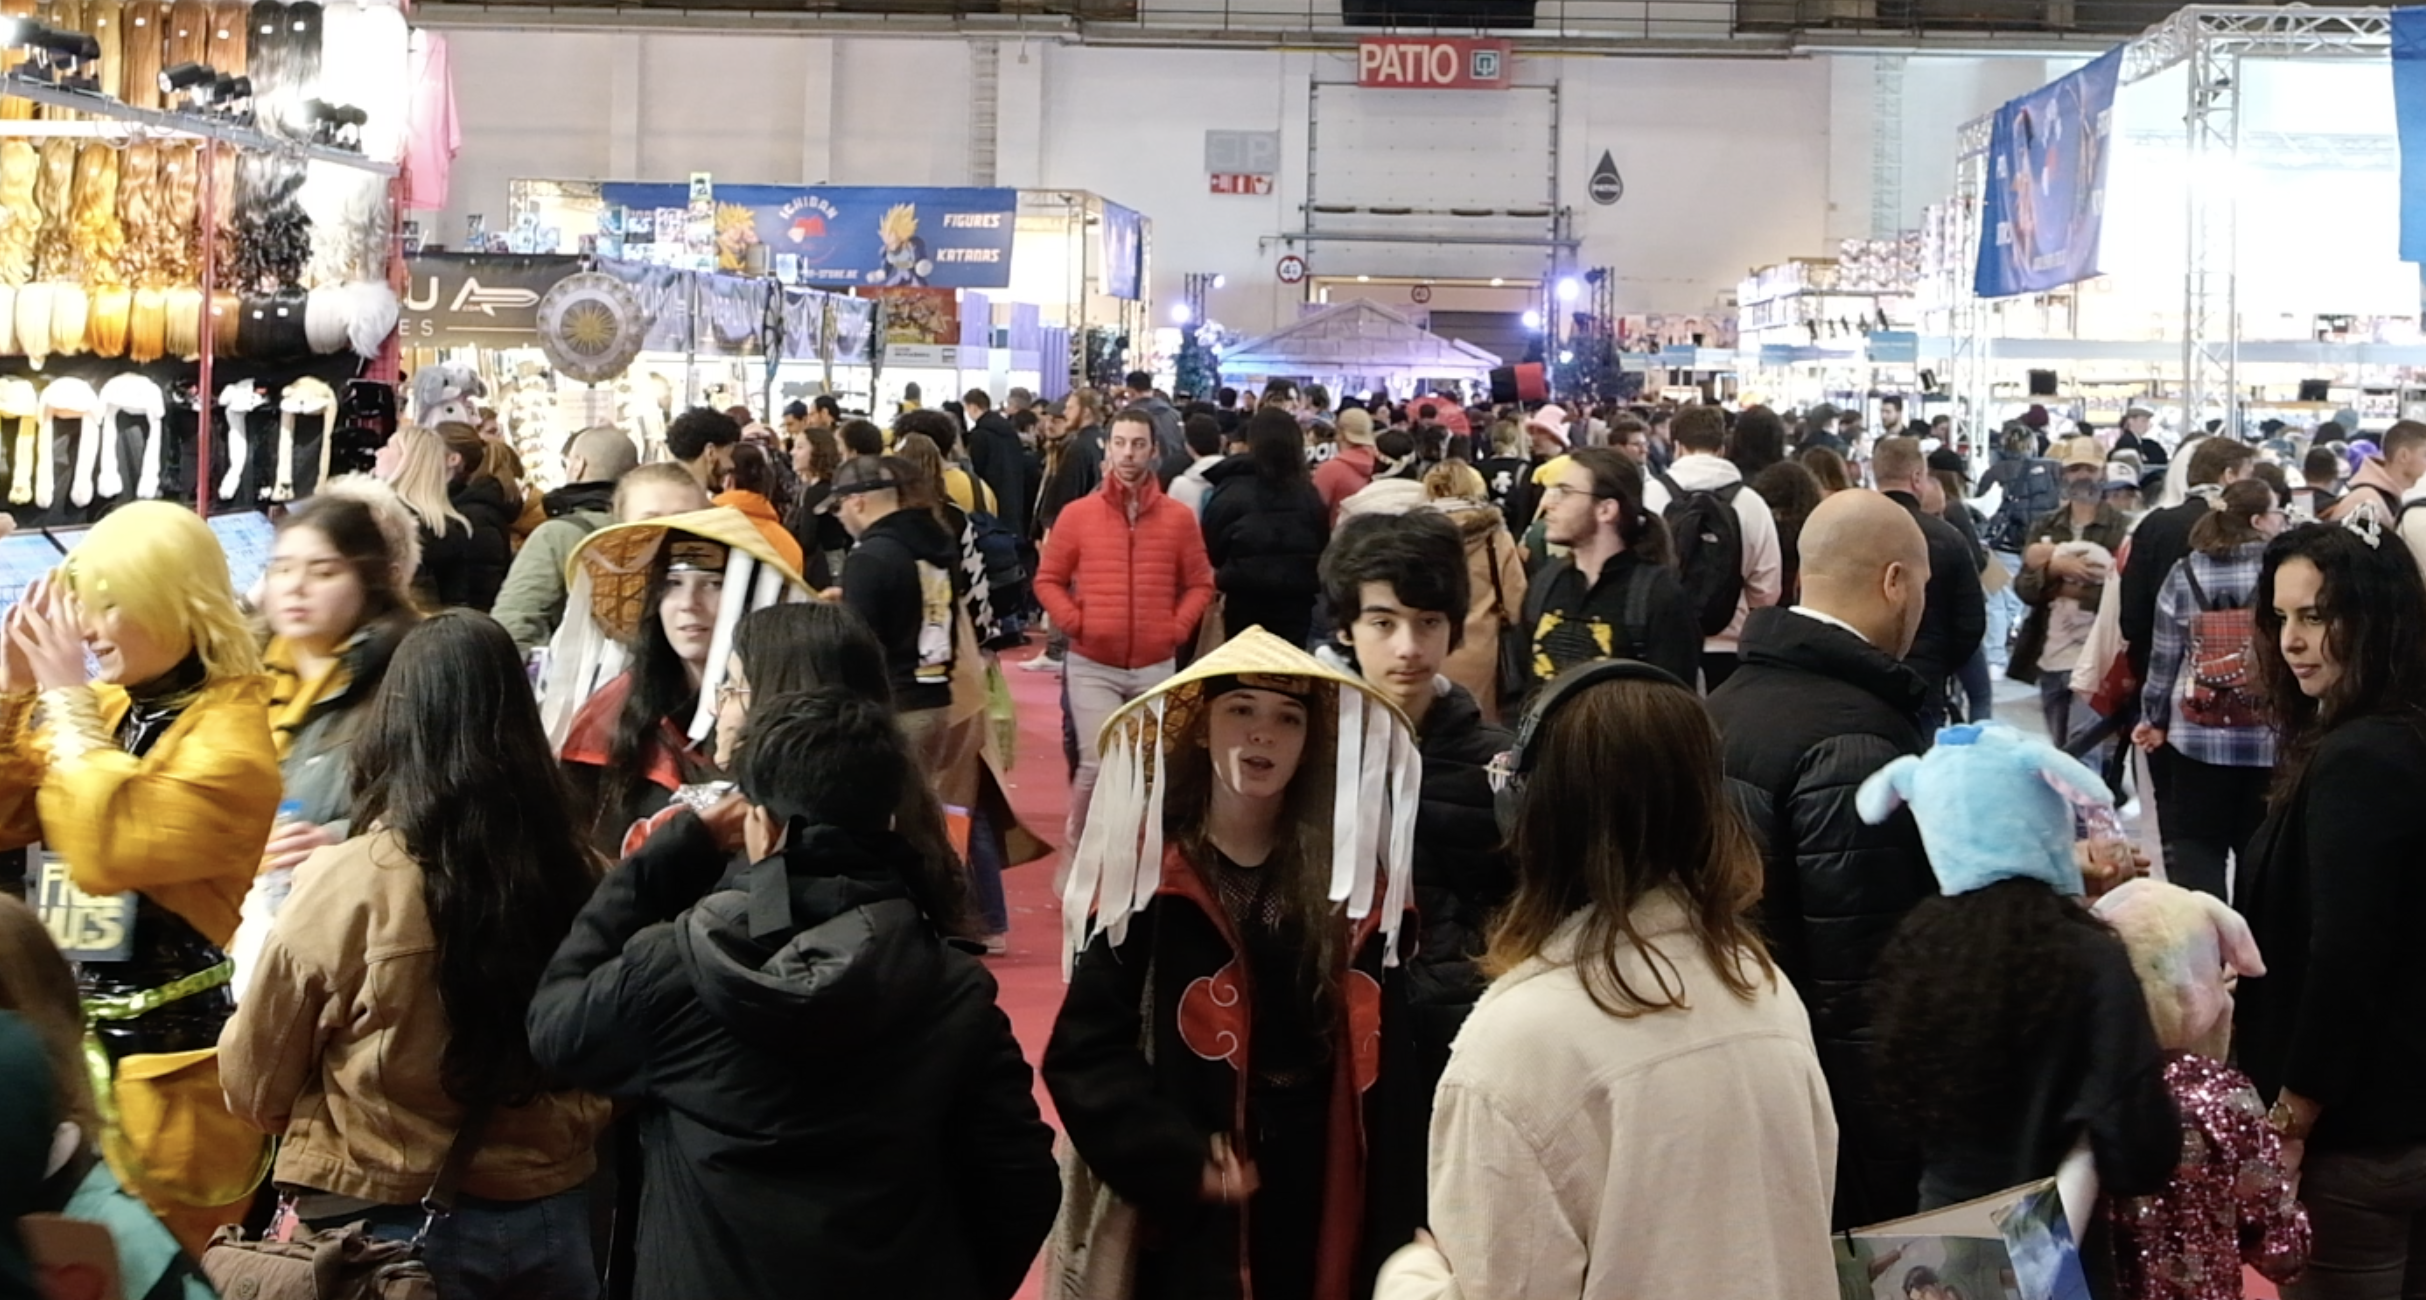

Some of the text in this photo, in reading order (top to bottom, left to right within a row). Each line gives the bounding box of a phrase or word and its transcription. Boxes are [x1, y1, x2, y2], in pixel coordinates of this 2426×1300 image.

[1359, 43, 1459, 84] PATIO
[943, 212, 1000, 229] FIGURES
[937, 248, 1000, 262] KATANAS
